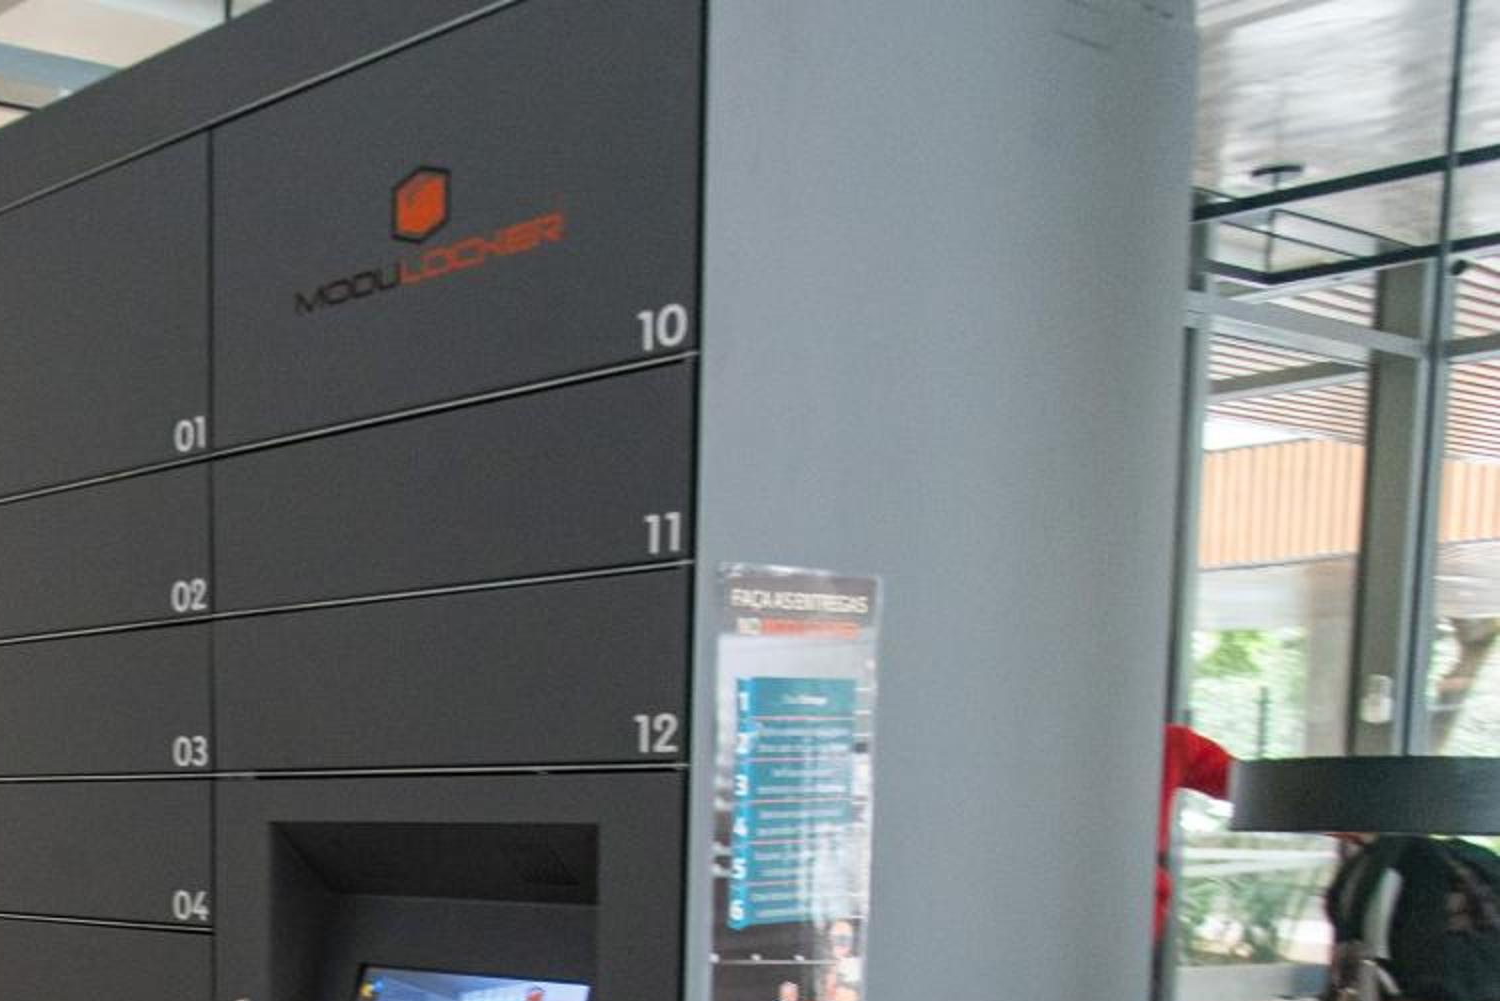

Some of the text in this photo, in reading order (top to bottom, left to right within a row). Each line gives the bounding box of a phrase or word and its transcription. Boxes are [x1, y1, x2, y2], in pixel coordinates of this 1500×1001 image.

[636, 302, 688, 352] 10
[173, 414, 206, 453] 01
[643, 510, 682, 555] 11
[171, 577, 207, 614] 02
[172, 734, 209, 768] 03
[633, 711, 680, 755] 12
[172, 889, 209, 922] 04
